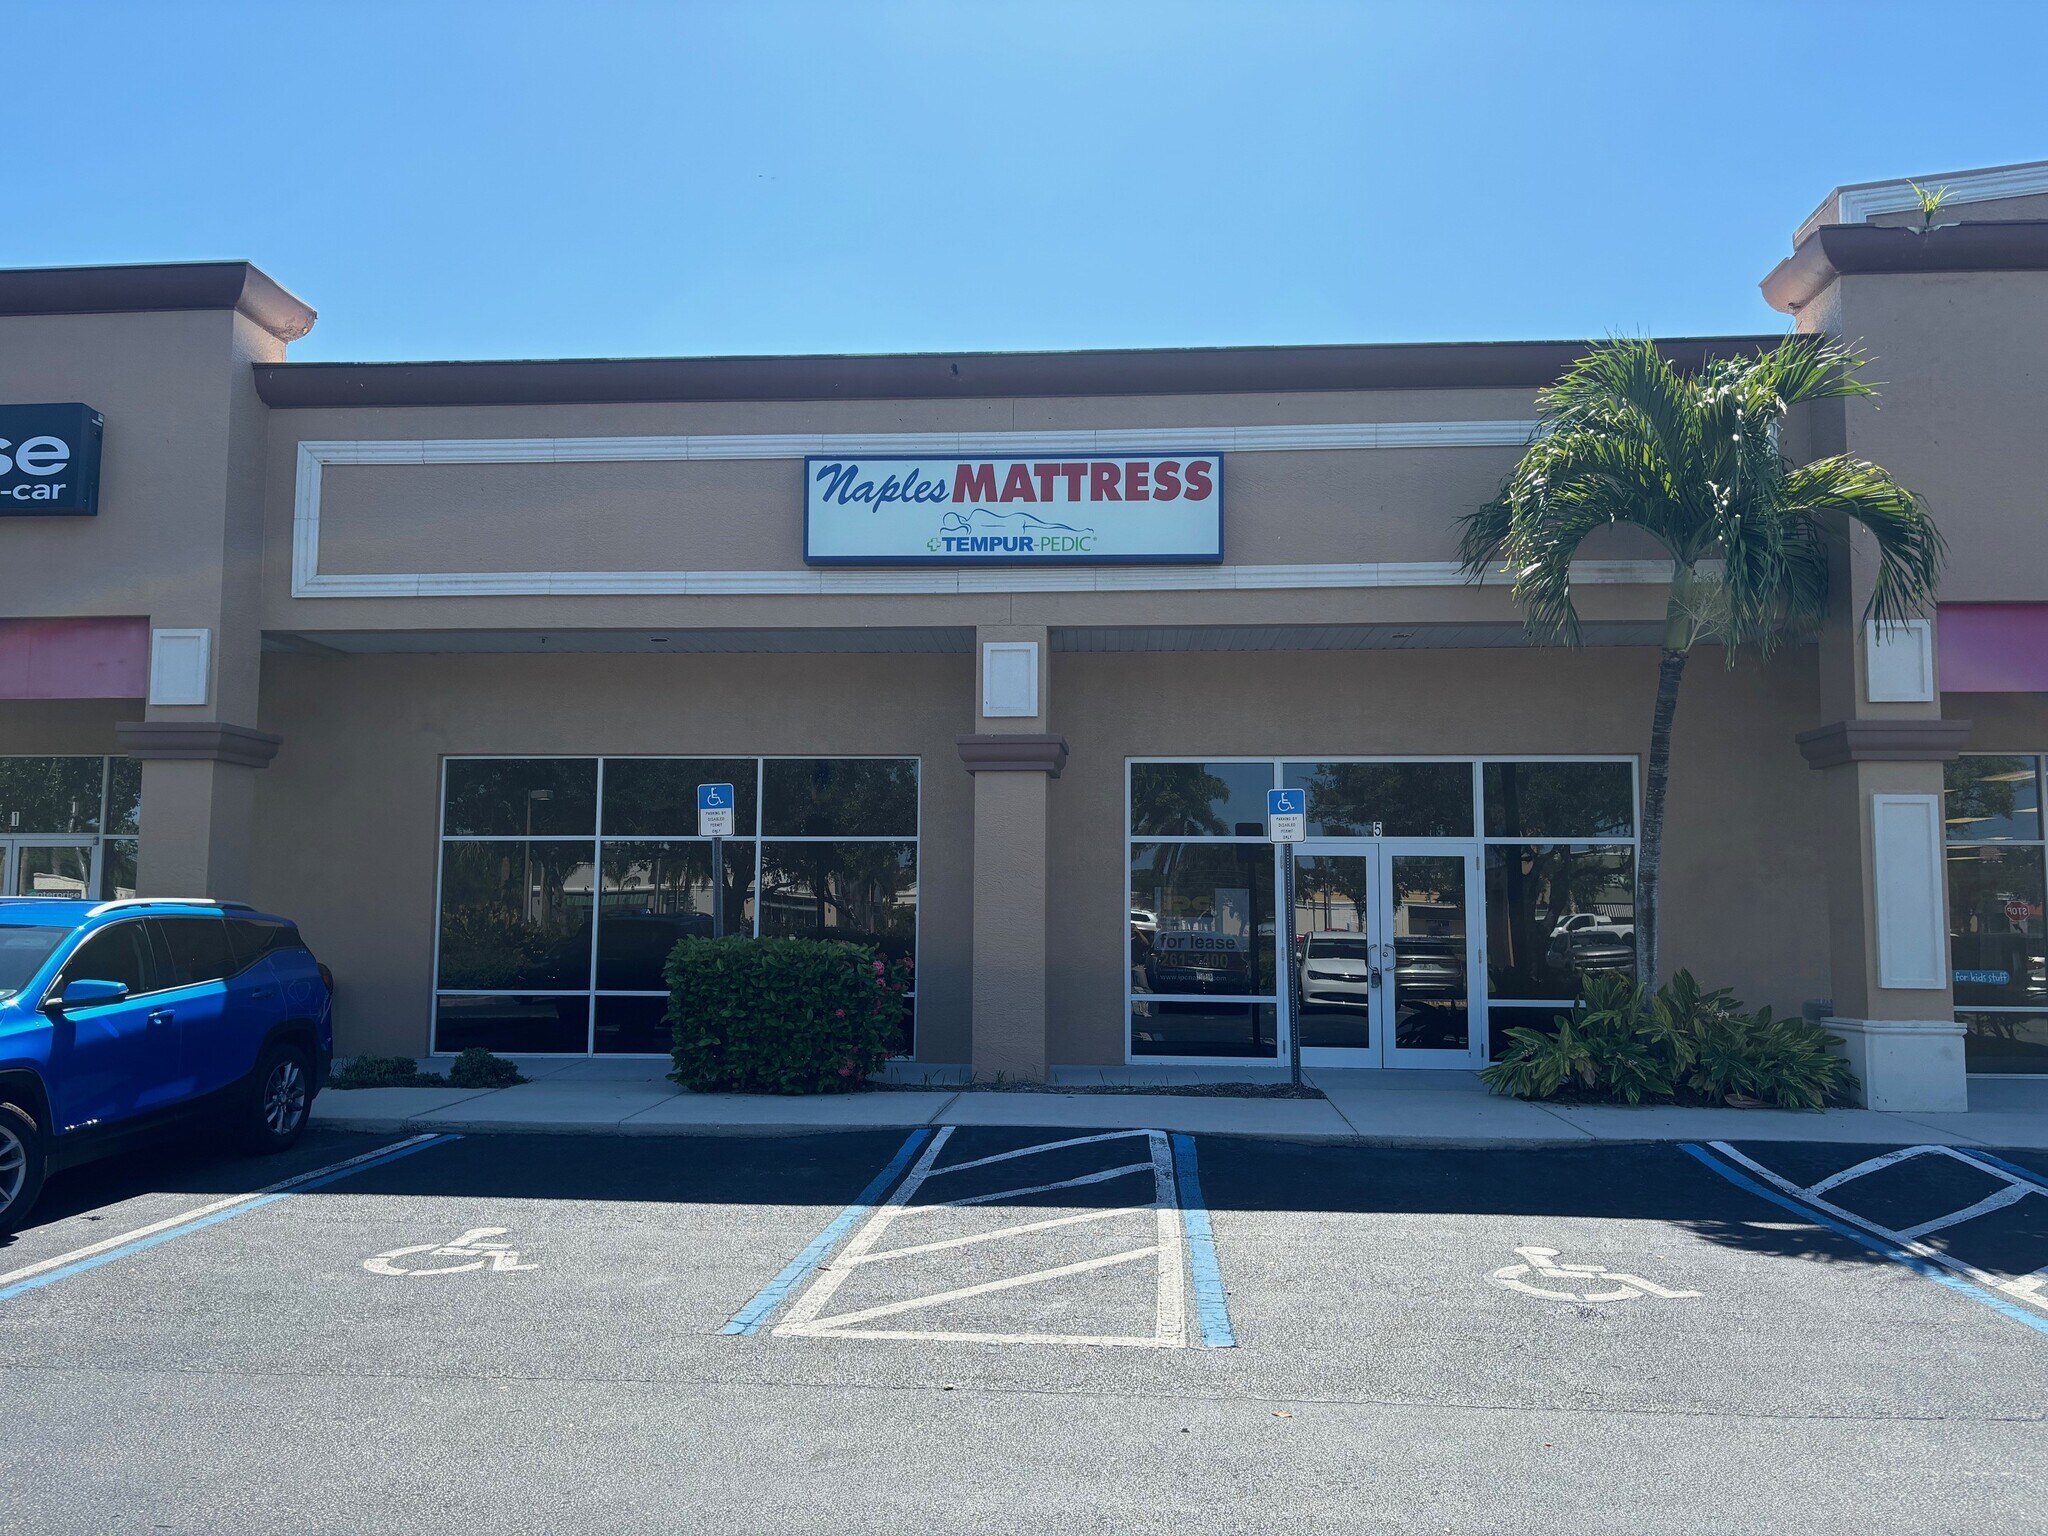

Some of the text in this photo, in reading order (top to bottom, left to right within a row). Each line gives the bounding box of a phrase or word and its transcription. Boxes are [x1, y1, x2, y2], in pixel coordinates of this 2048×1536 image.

[816, 460, 1213, 513] Naples MATTRESS
[941, 536, 1091, 553] TEMPUR-PEDIC
[1374, 822, 1382, 837] 5
[1160, 933, 1236, 950] for lease
[1955, 971, 2008, 984] for kids stuff
